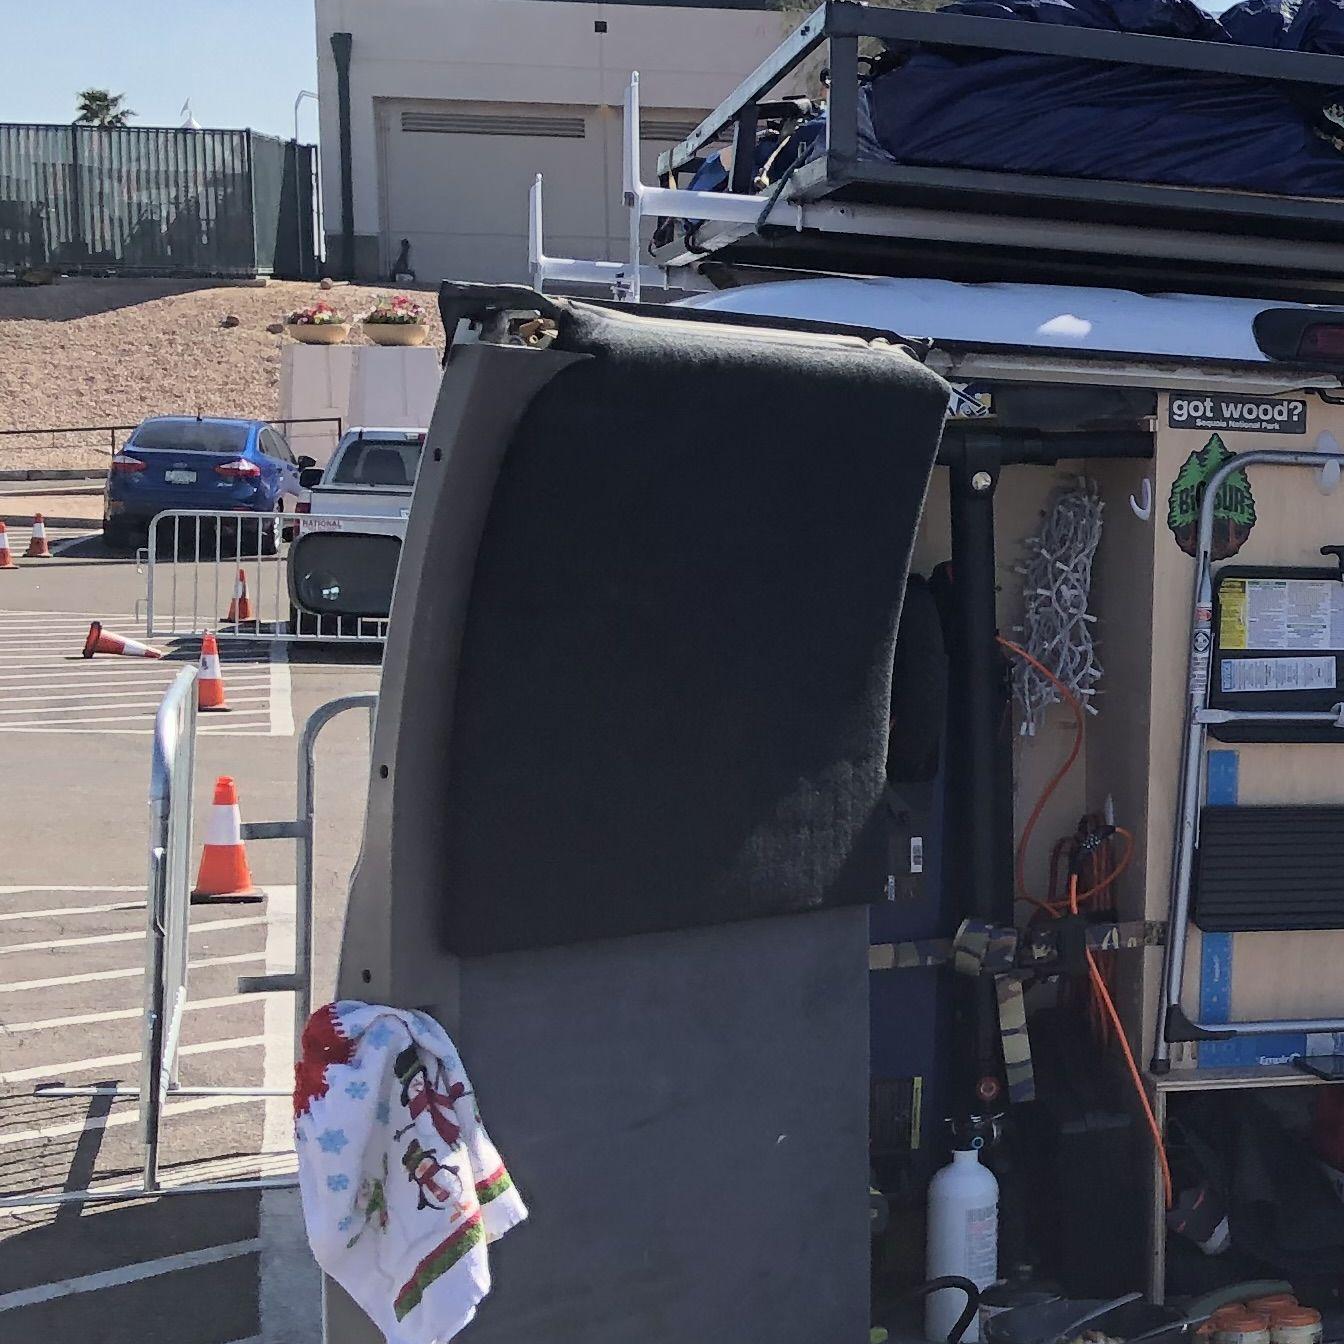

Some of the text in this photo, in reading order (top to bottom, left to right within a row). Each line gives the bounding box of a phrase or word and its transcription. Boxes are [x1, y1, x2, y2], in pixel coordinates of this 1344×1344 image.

[1172, 397, 1303, 422] got wood?
[302, 519, 342, 529] NATIONAL
